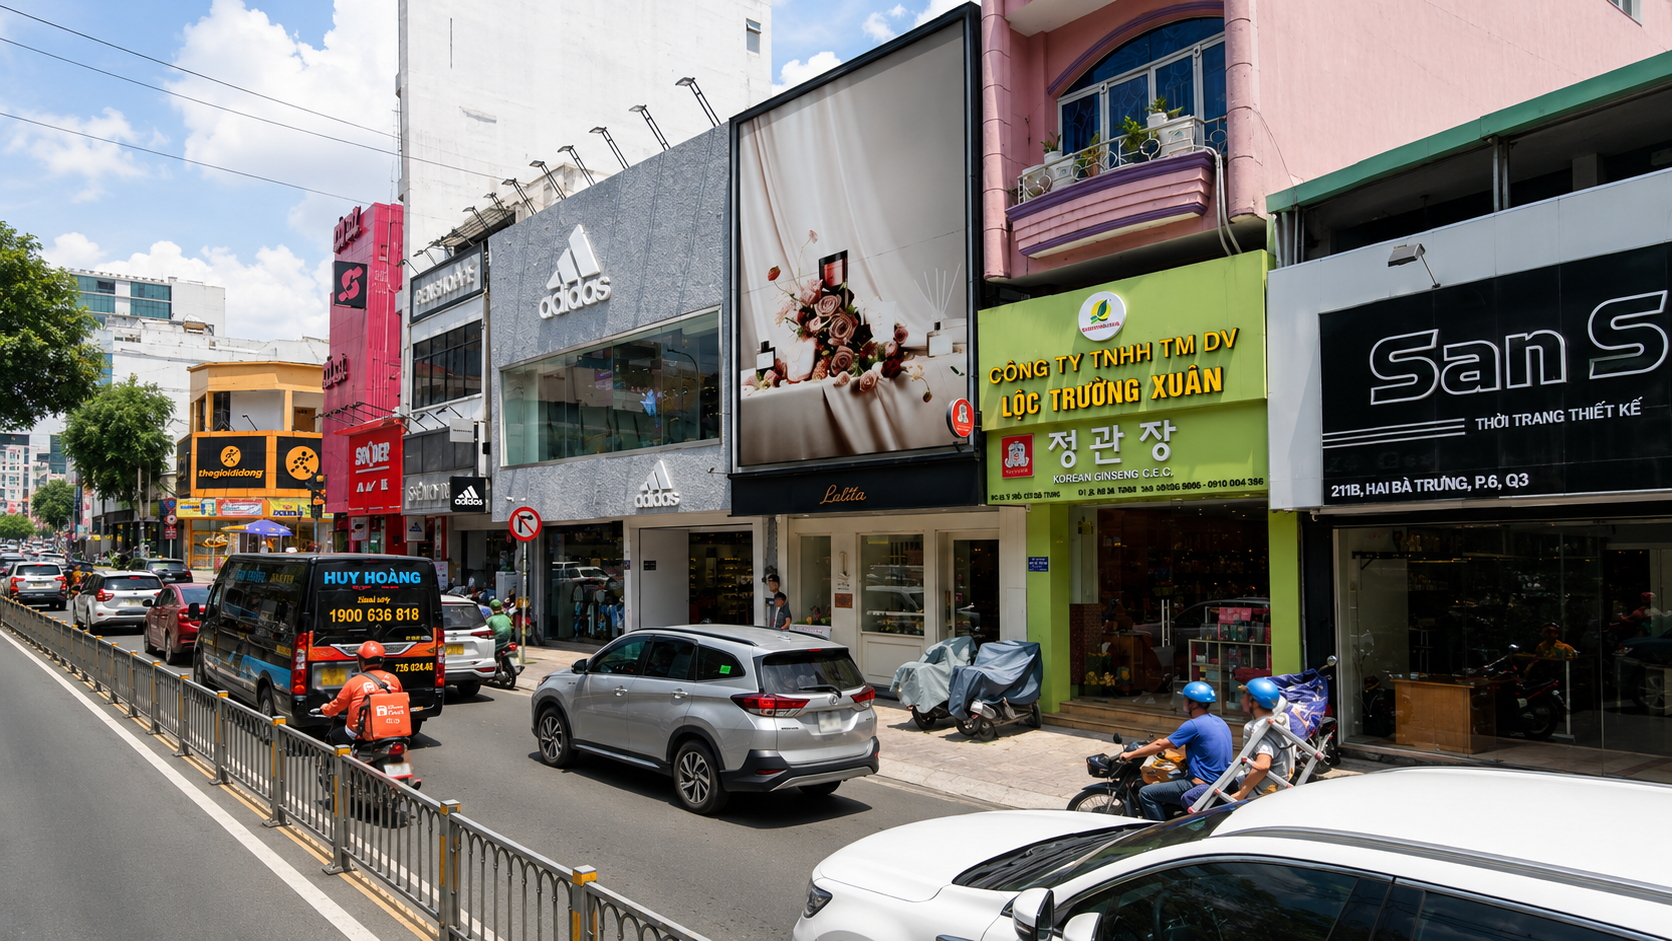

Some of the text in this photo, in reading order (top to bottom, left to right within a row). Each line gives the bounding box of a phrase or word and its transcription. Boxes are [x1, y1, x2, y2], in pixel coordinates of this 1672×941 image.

[539, 277, 612, 319] adidas
[989, 327, 1240, 385] CÔNG TY TNHH TM DV
[1369, 328, 1568, 406] San
[1002, 364, 1224, 421] LỘC TRƯỜNG XUÂN
[1475, 396, 1644, 431] THỜI TRANG THIẾT KẾ
[1048, 419, 1178, 469] 정관장
[1053, 473, 1092, 484] KOREAN
[1094, 470, 1139, 483] GINSENG
[1207, 479, 1228, 488] 0910
[1230, 478, 1246, 487] 004
[1331, 472, 1530, 499] 211B, HAI BÀ TRƯNG, P.6, Q3
[634, 489, 680, 508] adidas
[819, 484, 867, 505] Lalita
[324, 568, 421, 585] HUY HOÀNG
[329, 607, 419, 622] 1900 636 818
